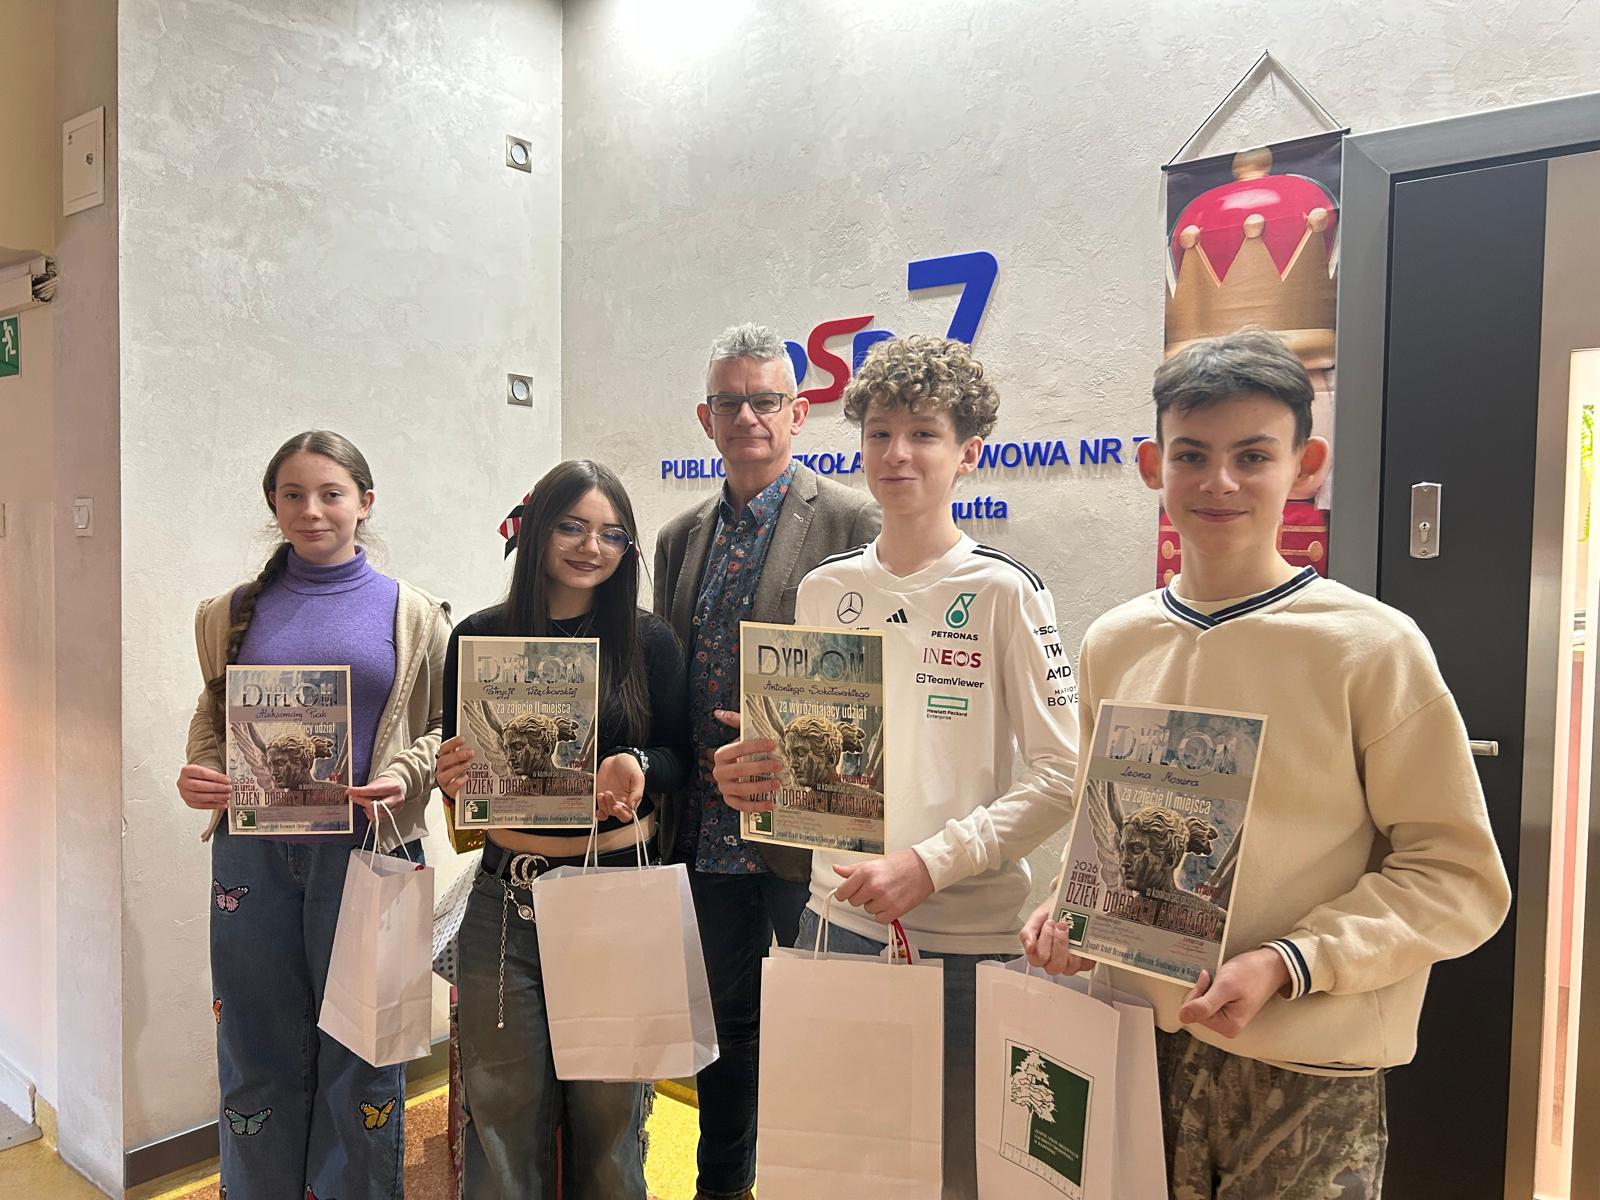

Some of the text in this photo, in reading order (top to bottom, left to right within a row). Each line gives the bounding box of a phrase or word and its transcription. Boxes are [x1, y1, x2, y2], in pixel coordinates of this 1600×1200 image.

[661, 458, 726, 479] PUBLIC
[977, 441, 1070, 469] WOWA
[1080, 438, 1122, 464] NR
[931, 630, 979, 641] PETRONAS
[923, 647, 982, 668] INEOS
[1044, 643, 1062, 658] IW
[758, 645, 864, 683] DYPLOM
[927, 674, 984, 689] TeamViewer
[1047, 666, 1072, 681] AMD
[496, 703, 505, 714] za
[541, 700, 571, 716] miejsca
[779, 701, 787, 713] za
[841, 703, 868, 720] udział
[466, 775, 493, 795] DZIEŃ
[235, 788, 260, 806] DZIEŃ
[1121, 788, 1132, 801] za
[1173, 793, 1212, 815] miejsca
[1073, 859, 1098, 874] 2026
[1077, 872, 1096, 885] EDYCJA
[1065, 881, 1101, 909] DZIEŃ
